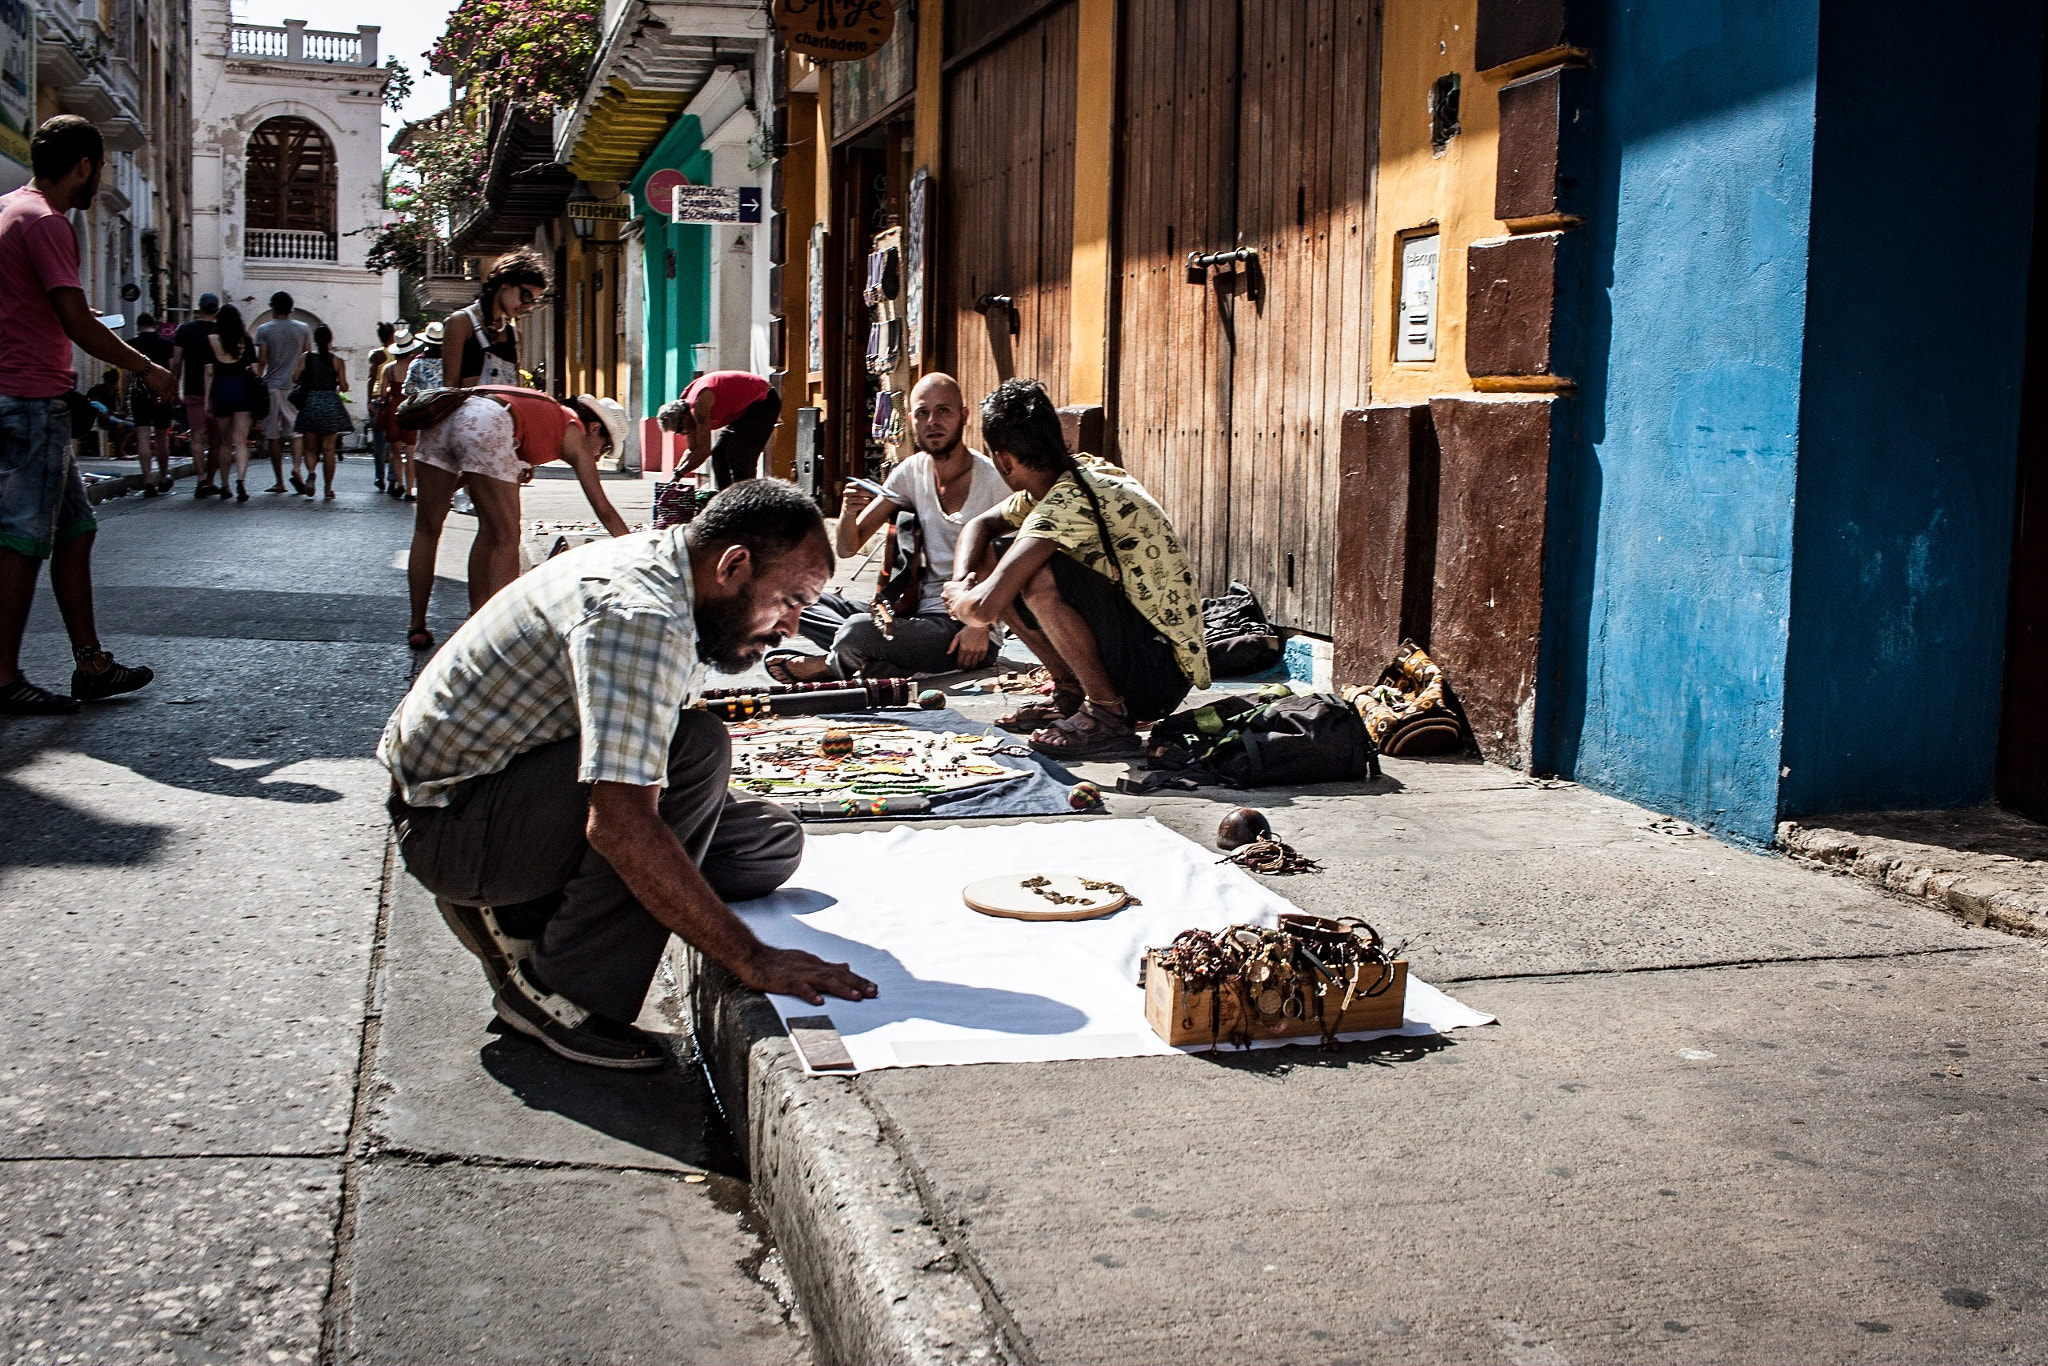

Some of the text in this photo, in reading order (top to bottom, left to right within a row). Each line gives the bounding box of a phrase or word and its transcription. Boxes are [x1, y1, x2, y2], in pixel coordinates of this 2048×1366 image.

[785, 0, 885, 31] Cllge
[795, 32, 867, 51] charladero
[681, 198, 722, 208] CAMBIO
[569, 204, 629, 219] FOTOCOPIAS
[680, 210, 738, 220] EXCHANGE
[1406, 252, 1437, 267] telecom
